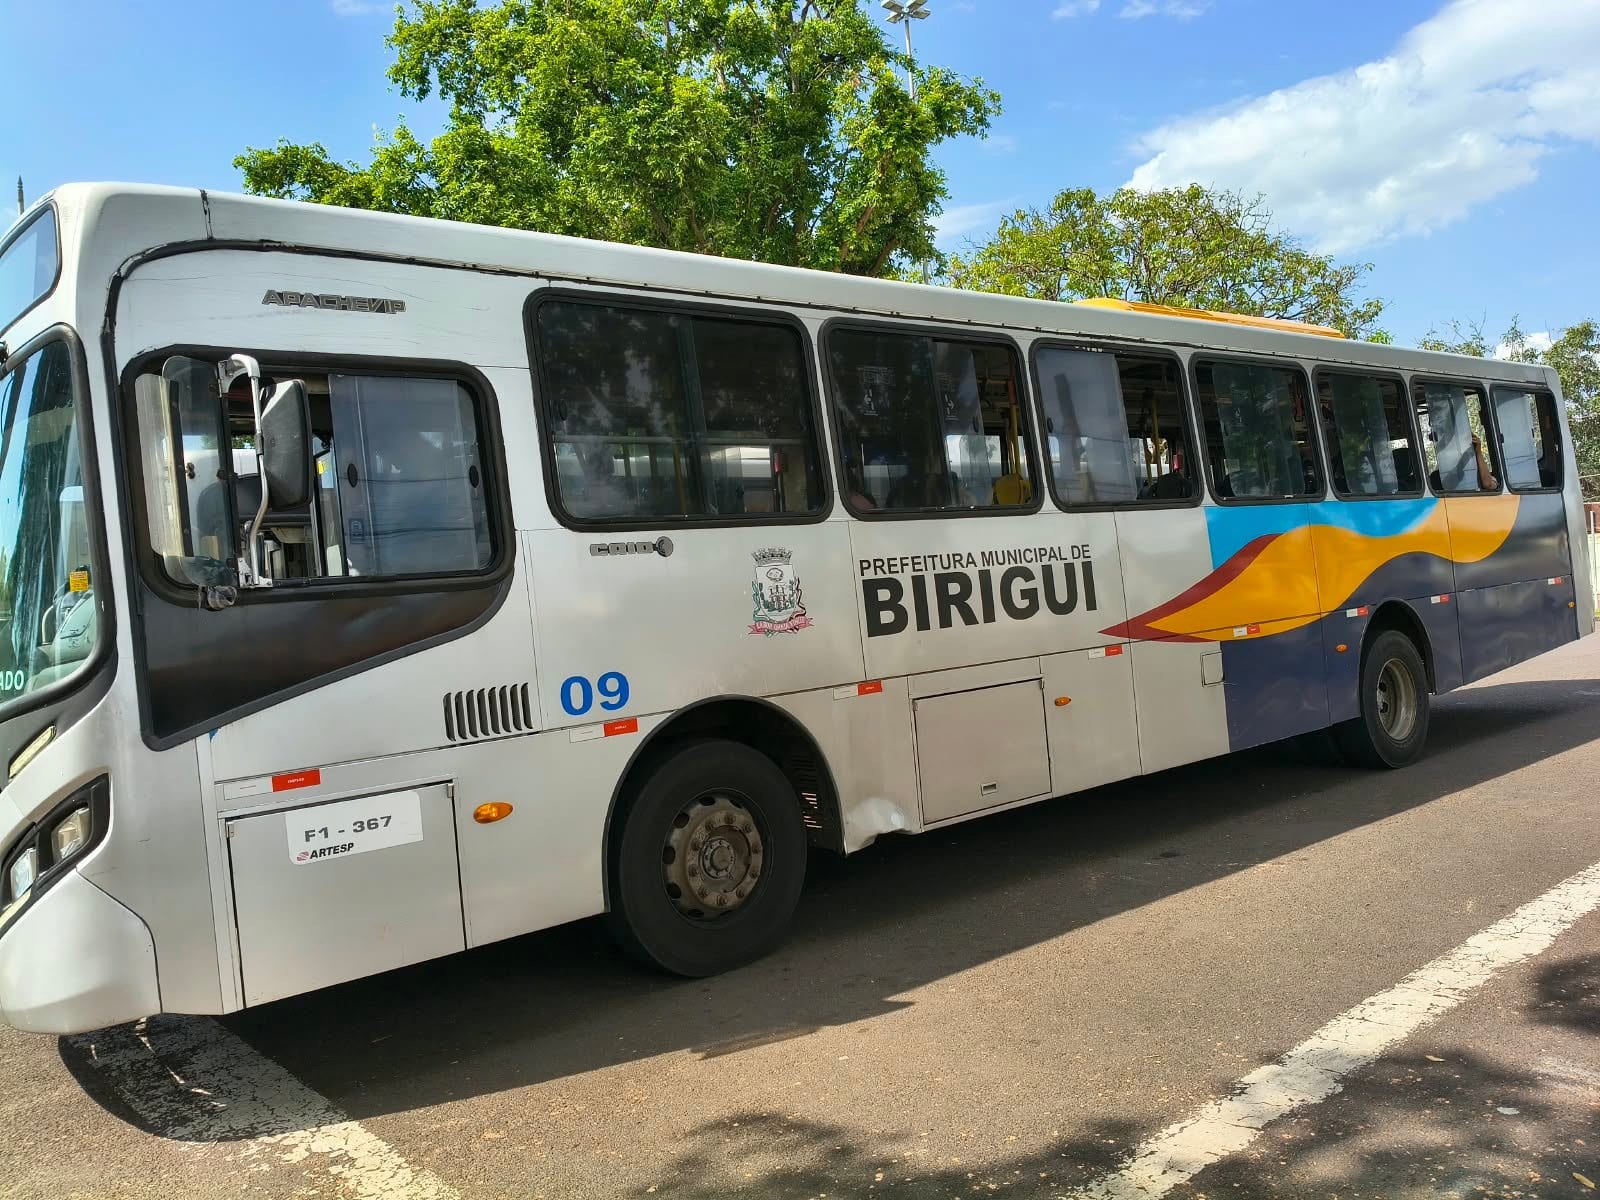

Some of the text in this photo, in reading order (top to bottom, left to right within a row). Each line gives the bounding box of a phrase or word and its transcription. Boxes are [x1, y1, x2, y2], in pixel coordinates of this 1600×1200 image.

[859, 544, 1091, 576] PREFEITURA MUNICIPAL DE
[862, 560, 1097, 638] BIRIGUI
[560, 671, 629, 716] 09
[304, 825, 330, 842] F1
[352, 815, 392, 834] 367
[309, 842, 354, 860] ARTESP
